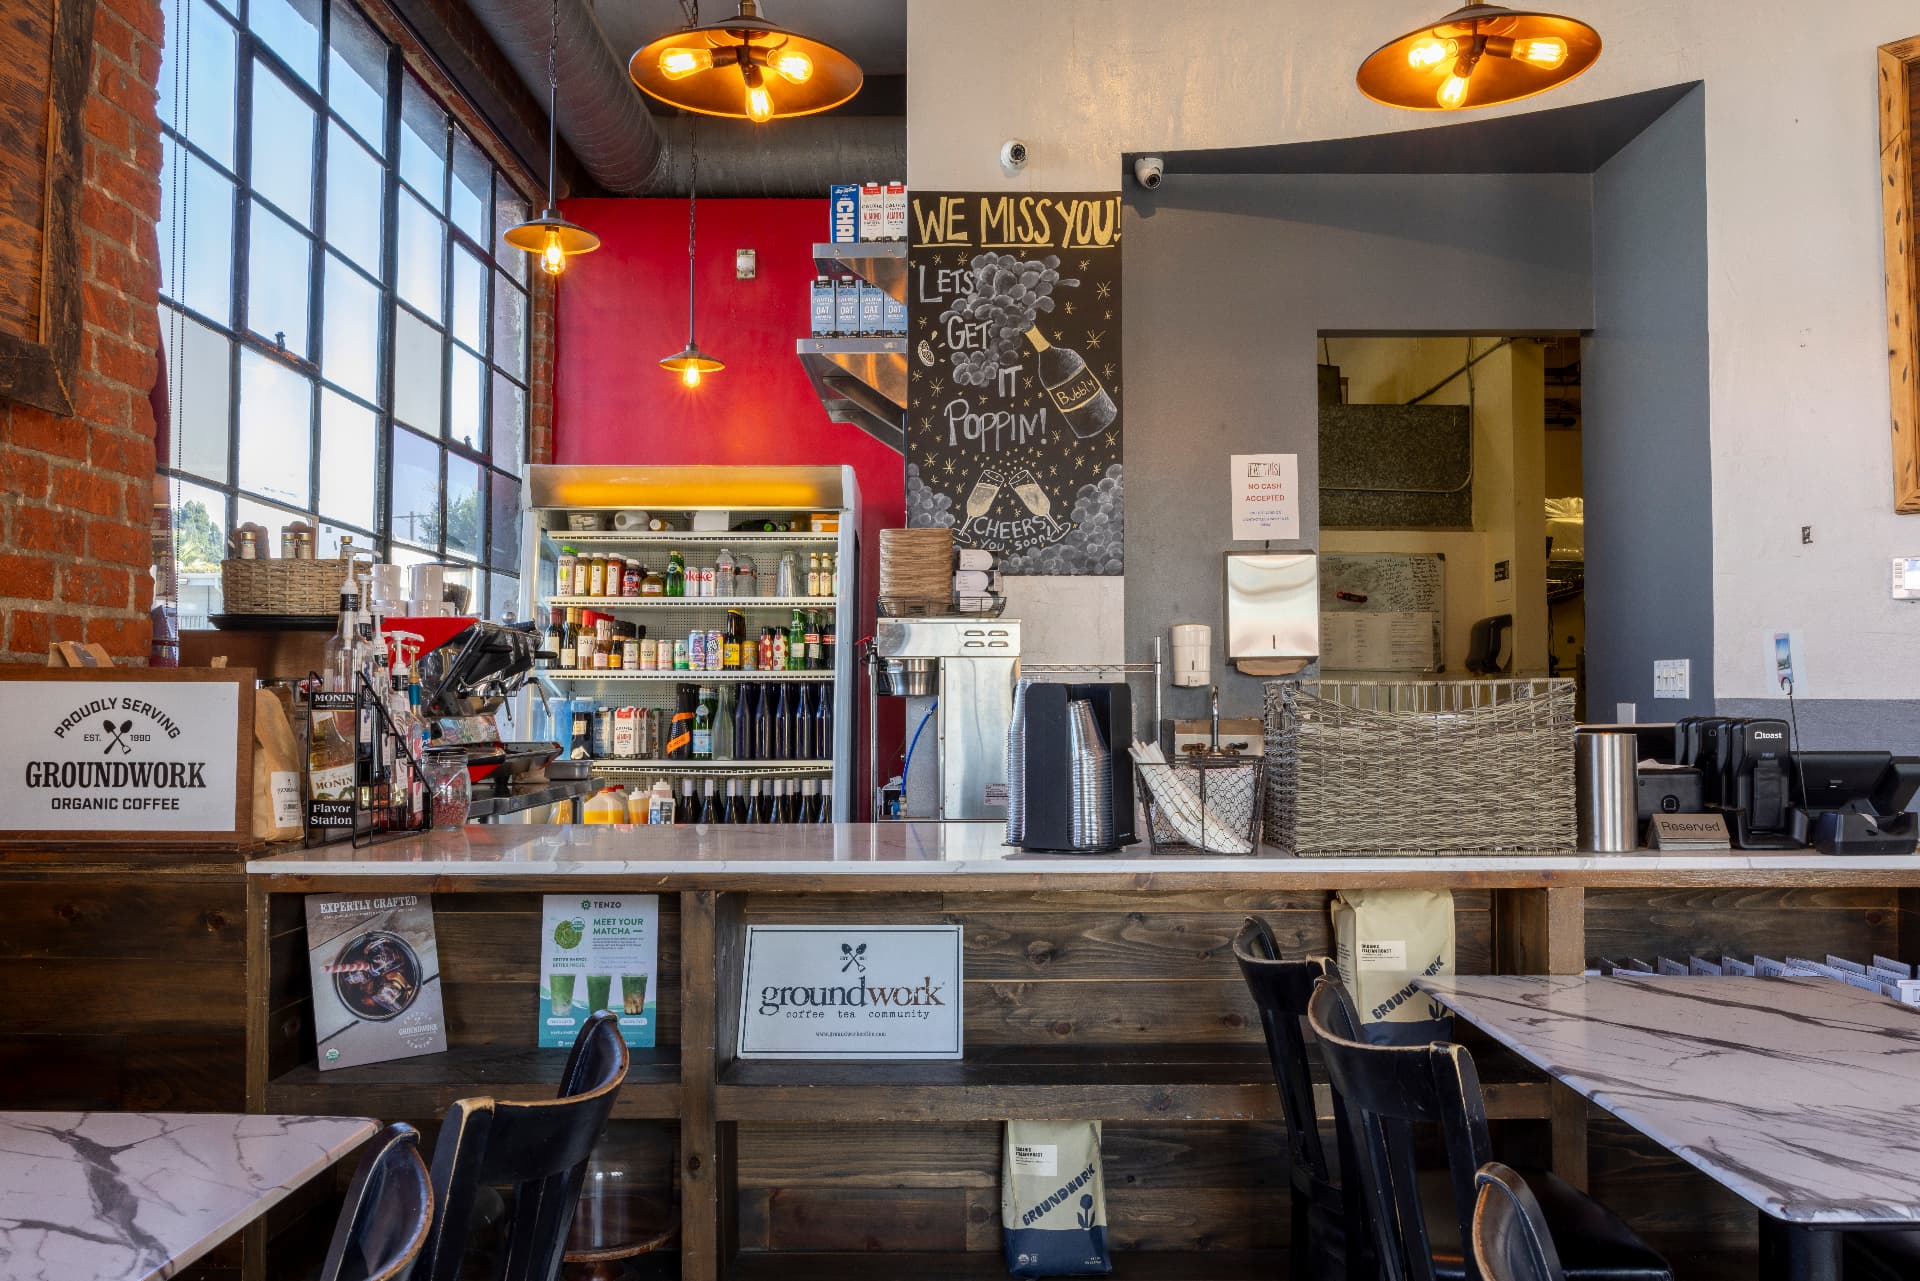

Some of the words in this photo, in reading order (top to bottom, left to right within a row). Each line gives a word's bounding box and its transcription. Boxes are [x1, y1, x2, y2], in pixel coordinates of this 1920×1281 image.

[836, 201, 855, 243] CHAI
[913, 196, 968, 244] WE
[981, 196, 1053, 244] MISS
[1055, 196, 1122, 249] YOU!
[919, 265, 975, 303] LETS
[947, 315, 994, 350] GET
[998, 365, 1023, 398] IT
[944, 399, 1047, 452] POPPIN!
[1261, 482, 1282, 490] CASH
[1245, 494, 1285, 502] ACCEPTED
[314, 694, 354, 702] MONIN
[54, 697, 118, 739] PROUDLY
[121, 698, 182, 739] SERVING
[84, 734, 102, 742] EST.
[130, 734, 151, 742] 1990
[25, 761, 207, 788] GROUNDWORK
[315, 775, 353, 790] MONIN
[51, 797, 119, 810] ORGANIC
[122, 797, 180, 810] COFFEE
[313, 803, 351, 813] Flavor
[310, 815, 353, 825] Station
[1661, 820, 1721, 832] Reserved
[320, 899, 371, 914] EXPERTLY
[373, 895, 418, 909] CRAFTED
[593, 901, 622, 909] TENZO
[593, 918, 617, 926] MEET
[619, 918, 644, 926] YOUR
[592, 927, 631, 935] MATCHA
[758, 976, 946, 1016] groundwork
[786, 1009, 825, 1019] coffee
[838, 1009, 856, 1019] tea
[868, 1008, 930, 1020] community
[1022, 1162, 1096, 1226] GROUNDWORK
